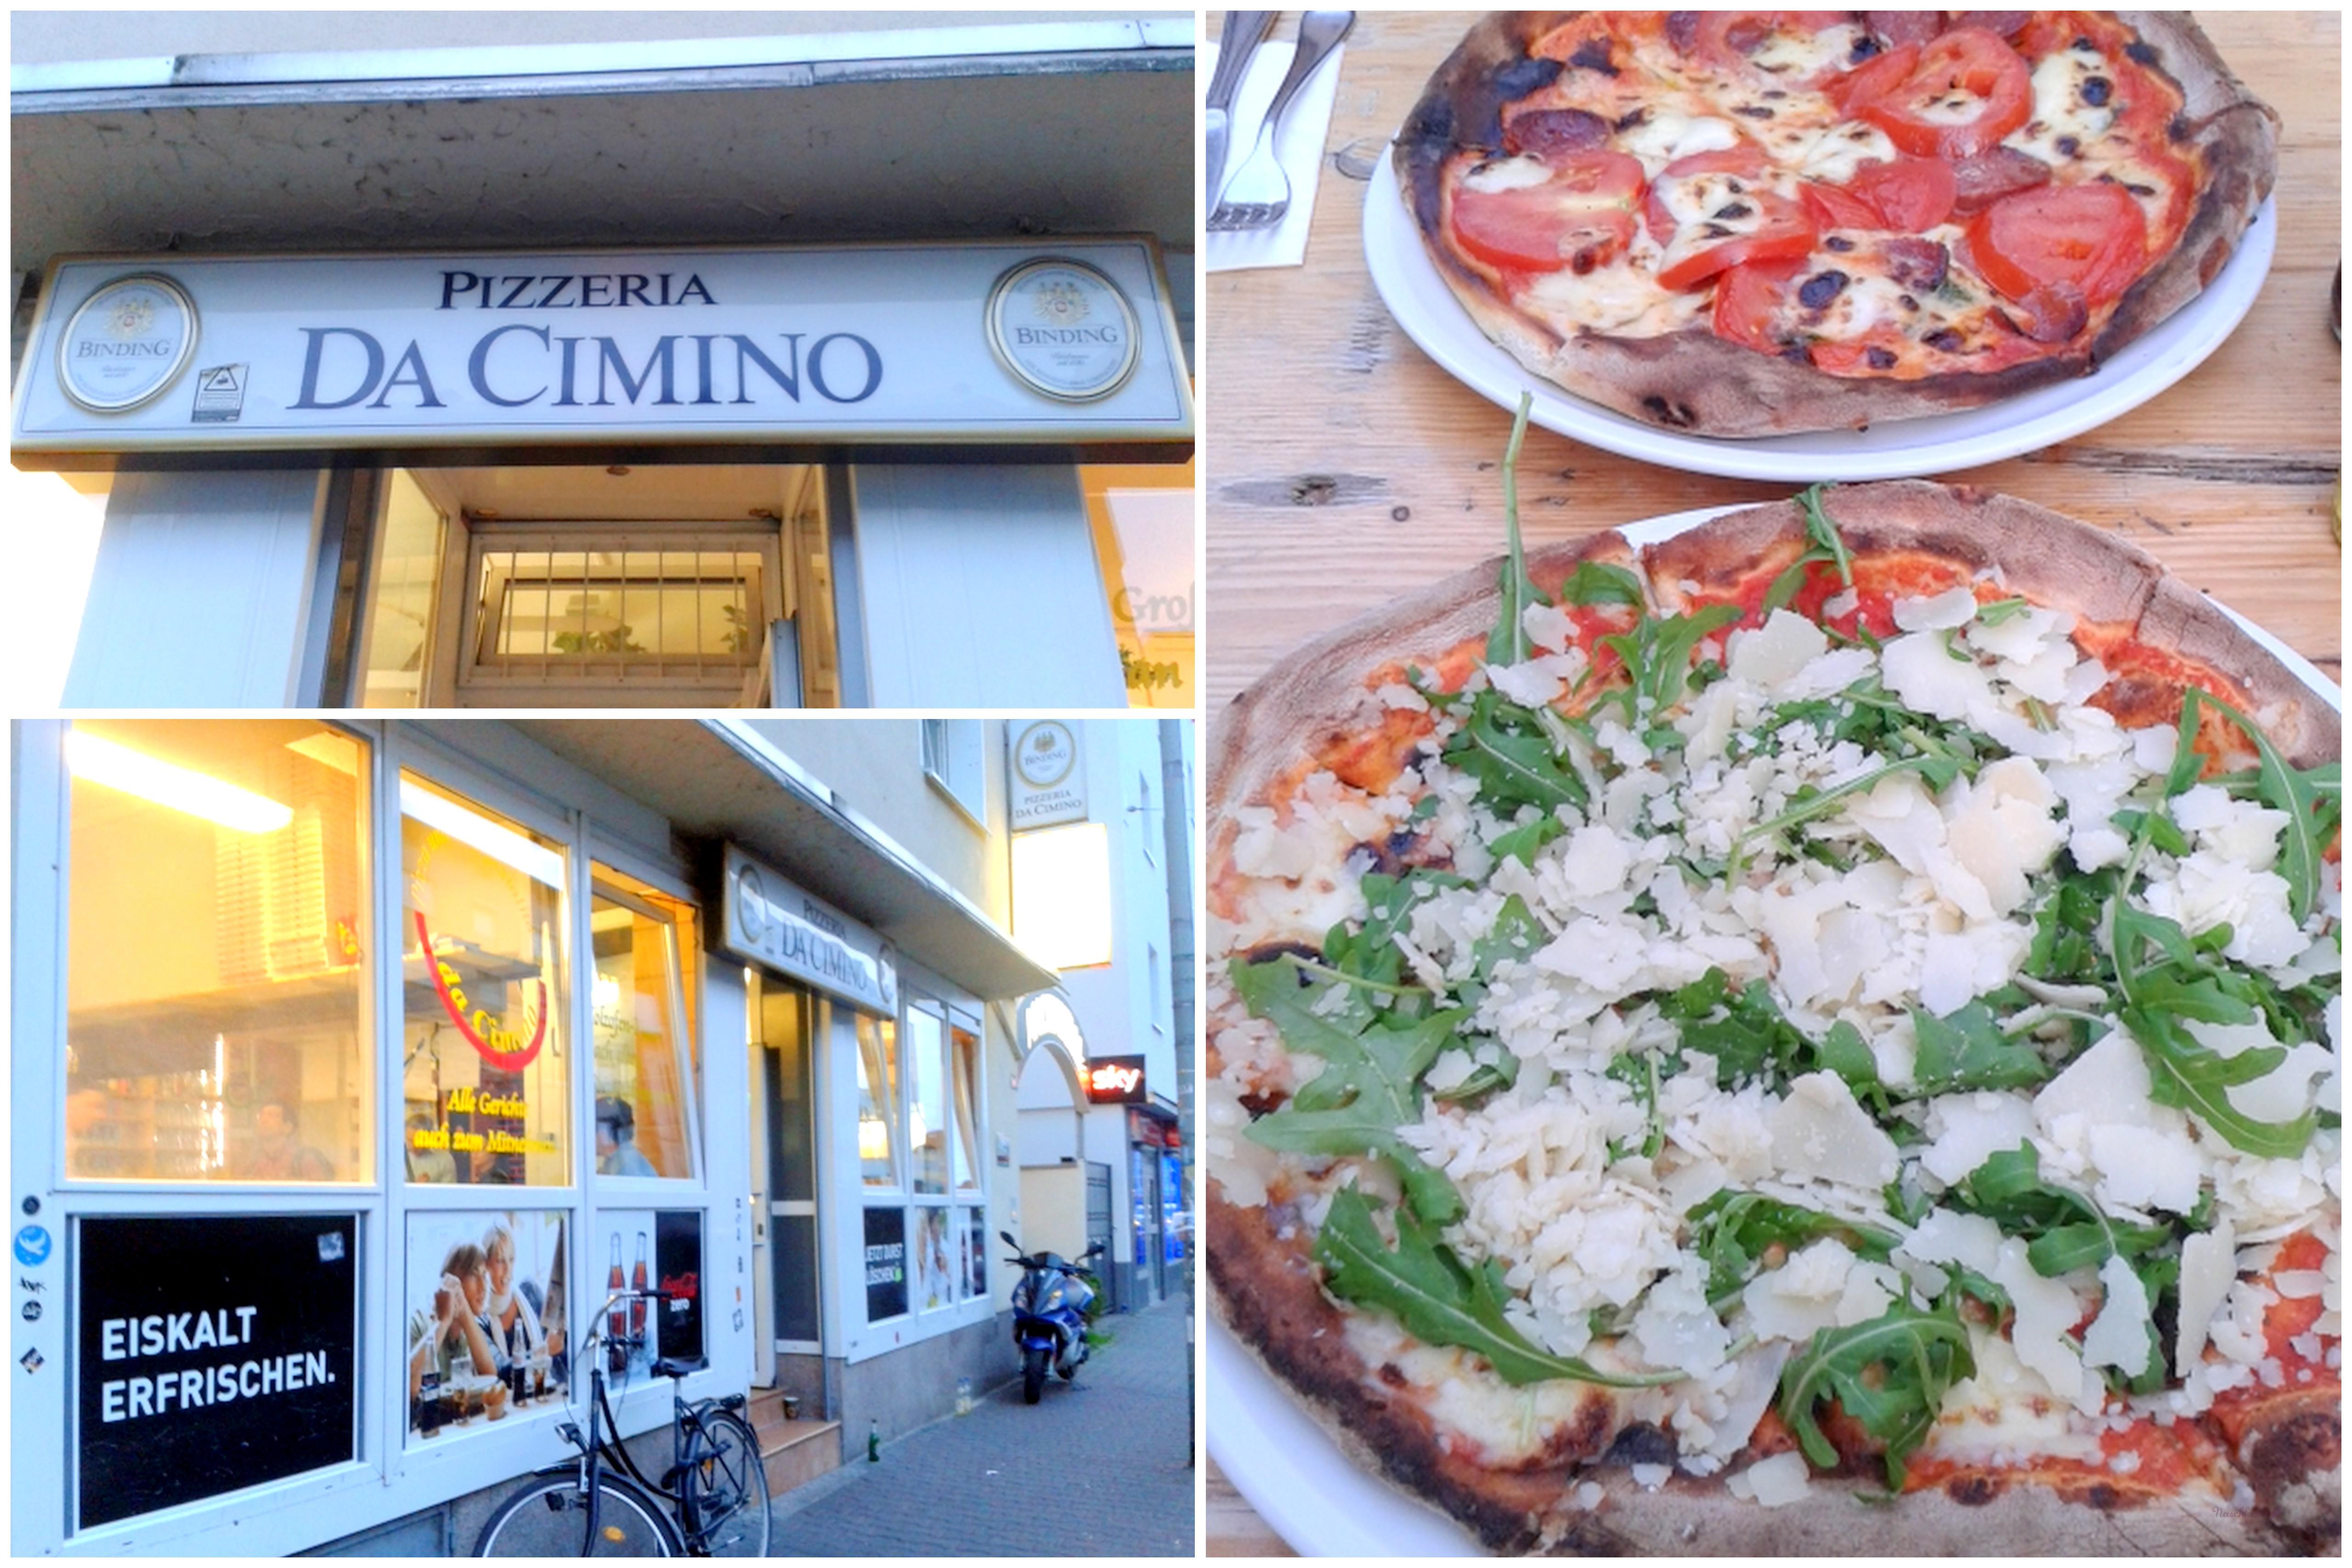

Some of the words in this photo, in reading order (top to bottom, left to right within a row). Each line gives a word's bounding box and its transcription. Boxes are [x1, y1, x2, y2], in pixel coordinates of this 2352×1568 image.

[439, 270, 719, 311] PIZZERIA
[76, 340, 170, 358] BINDING
[1015, 326, 1118, 345] BINDING
[285, 327, 447, 410] DA
[467, 324, 883, 407] CIMINO
[1015, 808, 1032, 818] DA
[1034, 798, 1082, 815] CIMINO
[1024, 790, 1071, 804] PIZZERIA
[782, 919, 807, 966] DA
[810, 933, 867, 991] CIMINO
[1091, 1064, 1140, 1093] sky
[447, 1085, 476, 1113] Alle
[102, 1305, 257, 1361] EISKALT
[102, 1349, 336, 1423] ERFRISCHEN.
